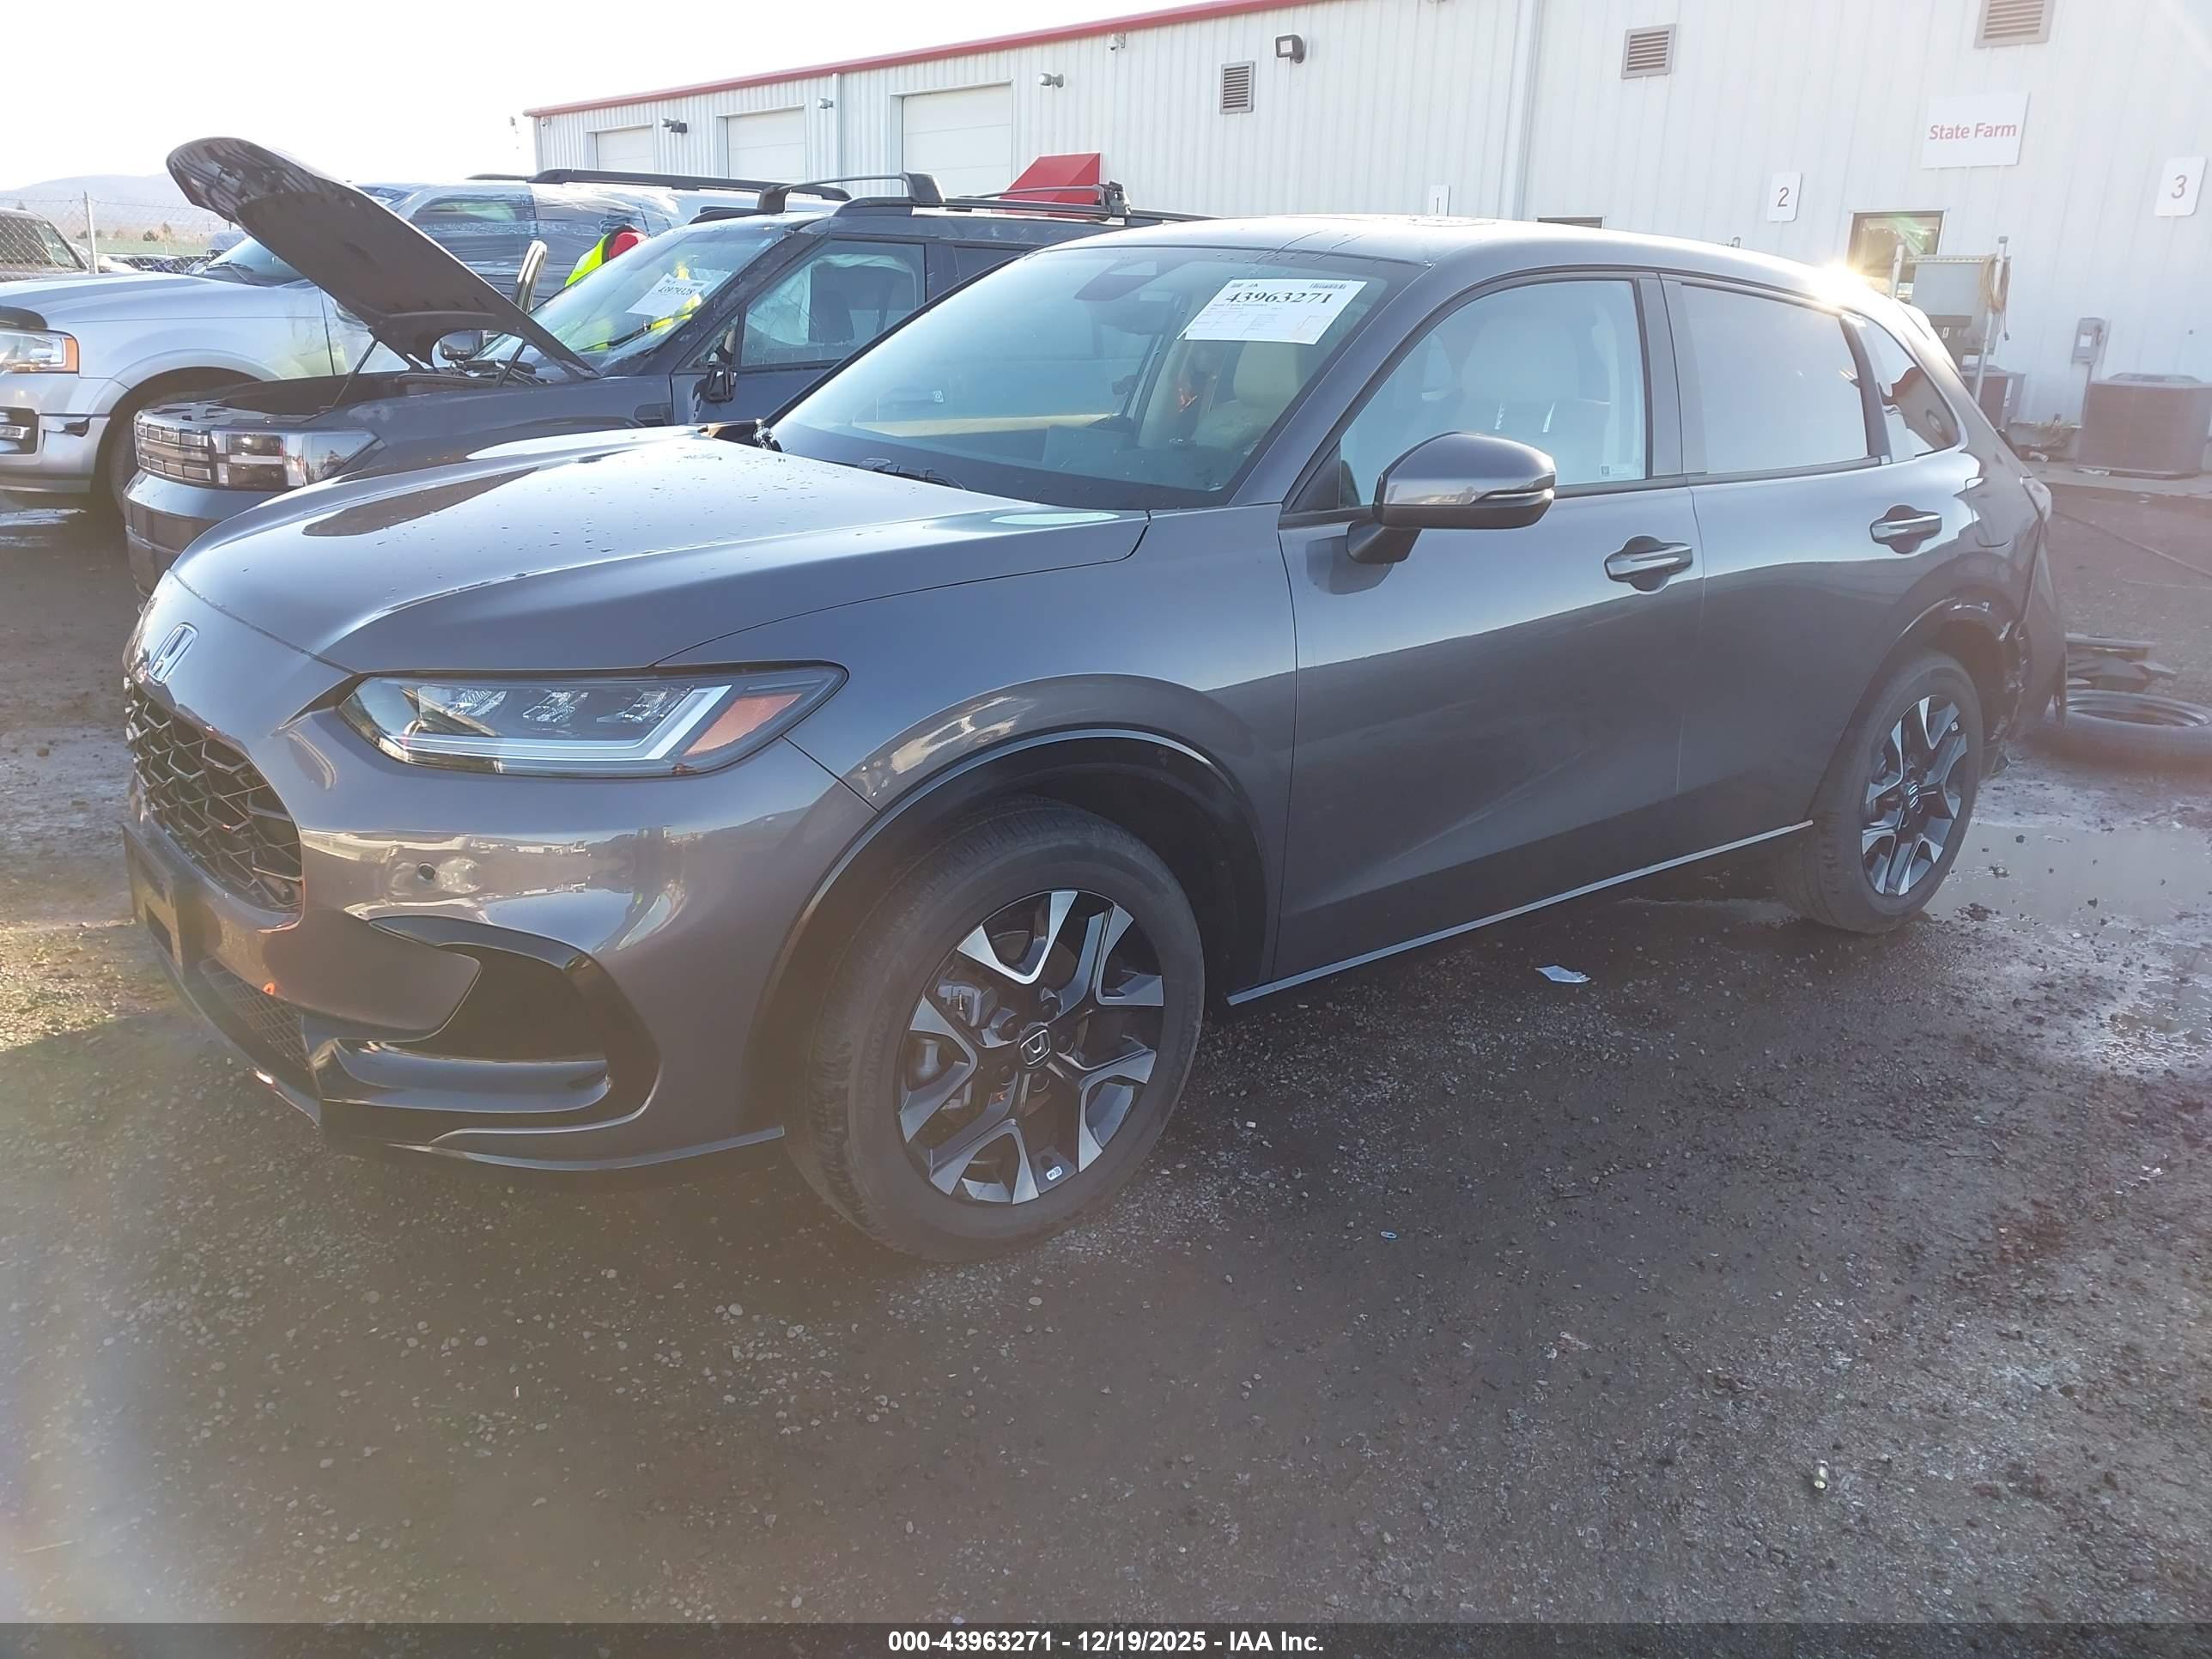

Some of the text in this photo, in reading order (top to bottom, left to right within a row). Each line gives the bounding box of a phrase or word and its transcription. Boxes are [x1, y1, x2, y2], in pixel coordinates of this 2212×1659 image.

[1929, 122, 2017, 140] State Farm
[2171, 174, 2187, 199] 3
[1778, 186, 1790, 207] 2
[1225, 291, 1333, 304] 43963271
